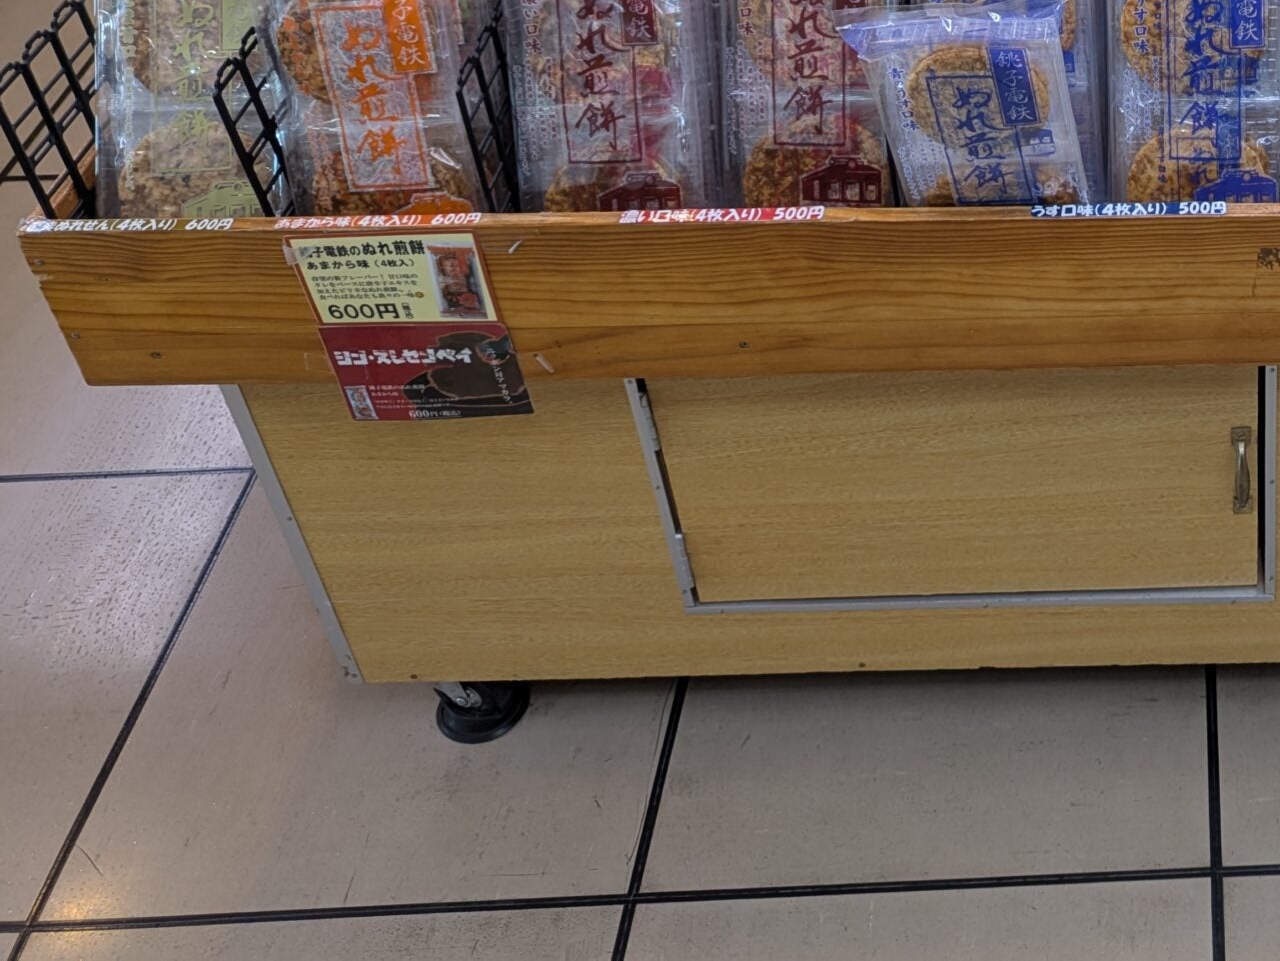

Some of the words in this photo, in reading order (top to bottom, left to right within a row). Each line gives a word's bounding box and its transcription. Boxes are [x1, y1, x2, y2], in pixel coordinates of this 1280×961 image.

[995, 50, 1035, 122] 銚子電鉄
[341, 20, 408, 176] ぬれ煎餅
[887, 67, 920, 132] 青のうす口味
[951, 86, 1018, 196] ぬれ煎餅
[773, 206, 825, 221] 500円
[1031, 203, 1167, 217] うす口味(4枚入り)
[1179, 201, 1227, 215] 500円
[185, 217, 234, 231] 600円
[275, 214, 421, 229] あまから味(4枚入り)
[431, 212, 482, 226] 600円
[327, 303, 400, 319] 600円
